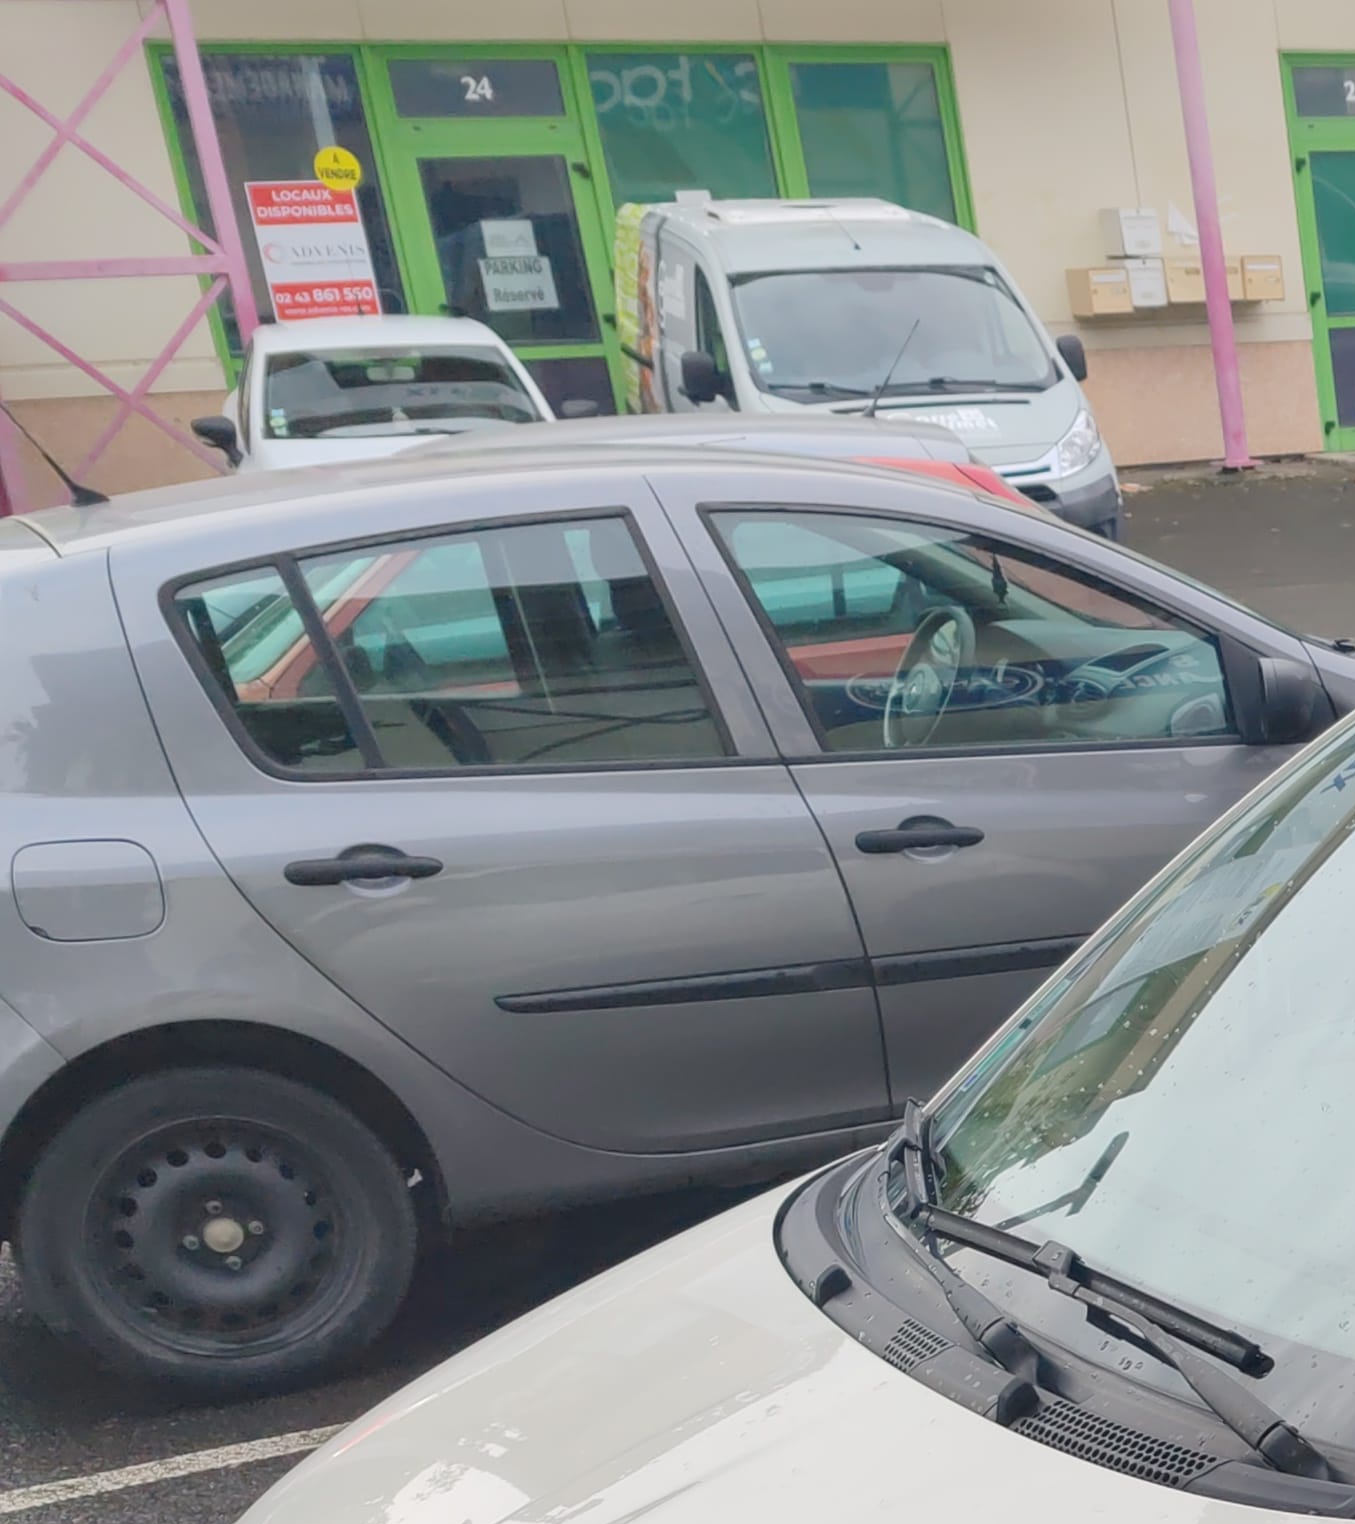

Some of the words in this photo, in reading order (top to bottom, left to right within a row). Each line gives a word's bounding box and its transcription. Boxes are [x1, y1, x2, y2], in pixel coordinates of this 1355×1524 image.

[460, 76, 494, 101] 24
[318, 168, 357, 181] VENDRE
[271, 189, 333, 202] LOCAUX
[256, 203, 354, 218] DISPONIBLES
[484, 257, 543, 275] PARKING
[275, 293, 291, 304] 02
[312, 287, 340, 302] 861
[343, 286, 373, 301] 550
